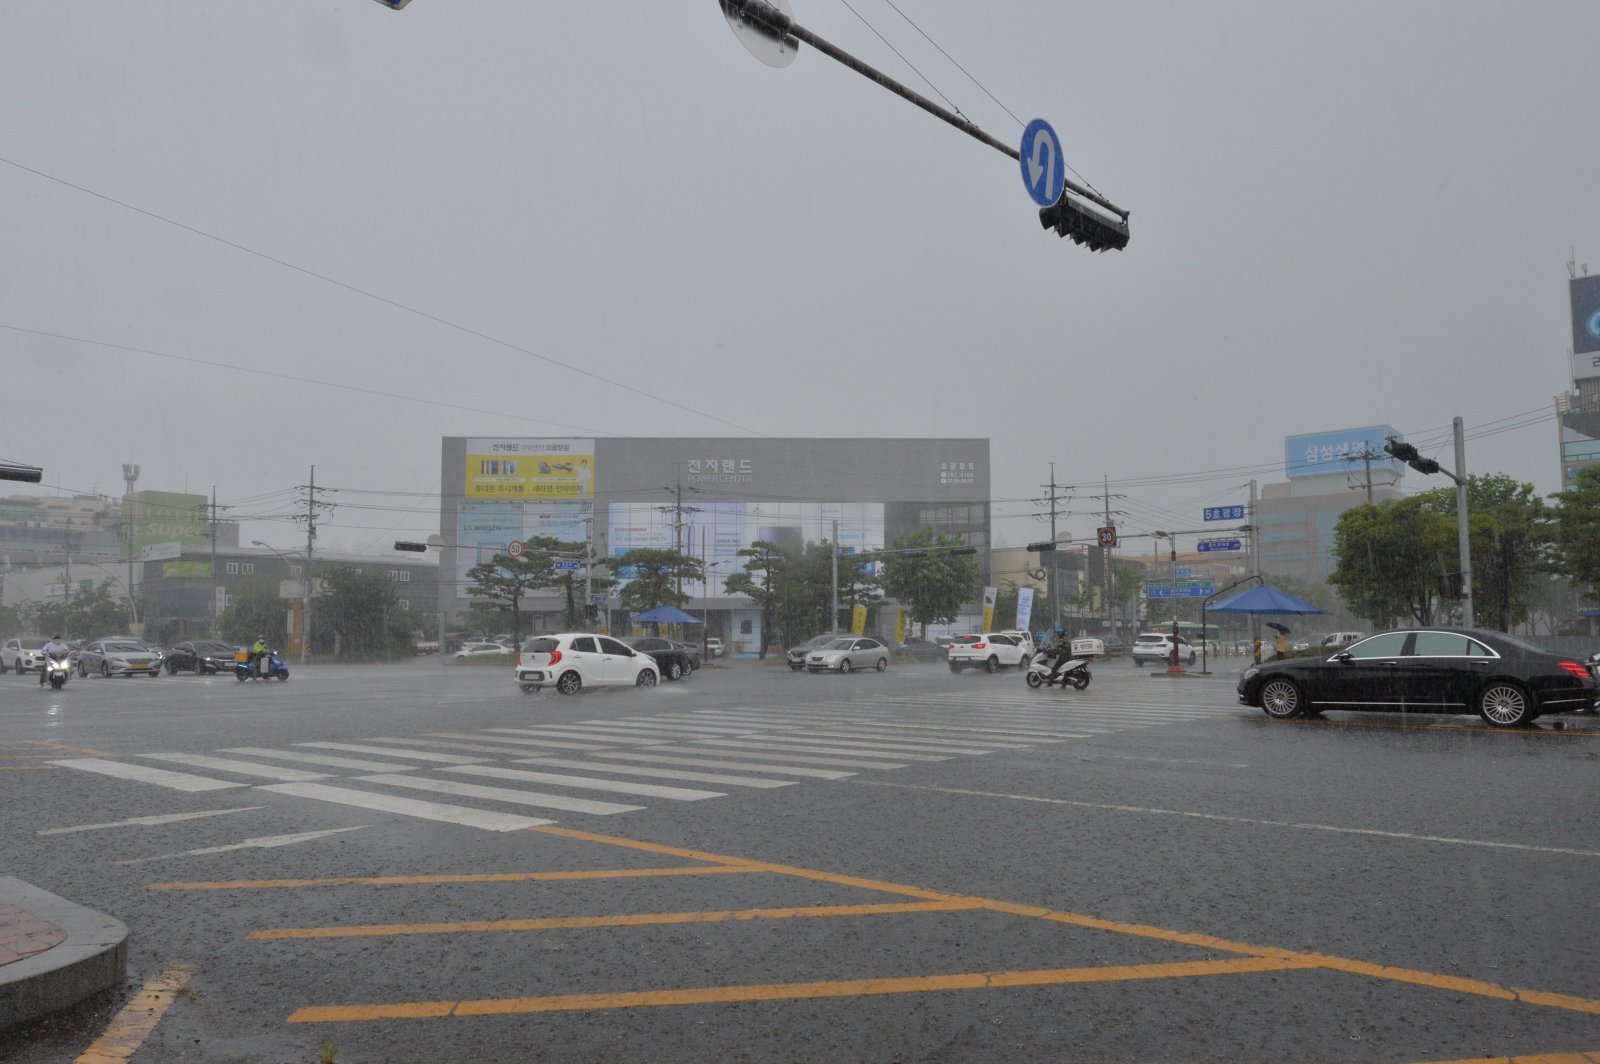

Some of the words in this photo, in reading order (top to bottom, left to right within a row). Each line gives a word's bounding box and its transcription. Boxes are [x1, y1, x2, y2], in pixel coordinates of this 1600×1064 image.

[688, 459, 753, 473] 전자랜드
[688, 474, 718, 483] POWER
[719, 474, 753, 483] CENTER
[475, 484, 496, 493] 휴대폰
[1205, 508, 1241, 519] 5호광장
[1101, 532, 1112, 542] 30
[511, 544, 520, 554] 50
